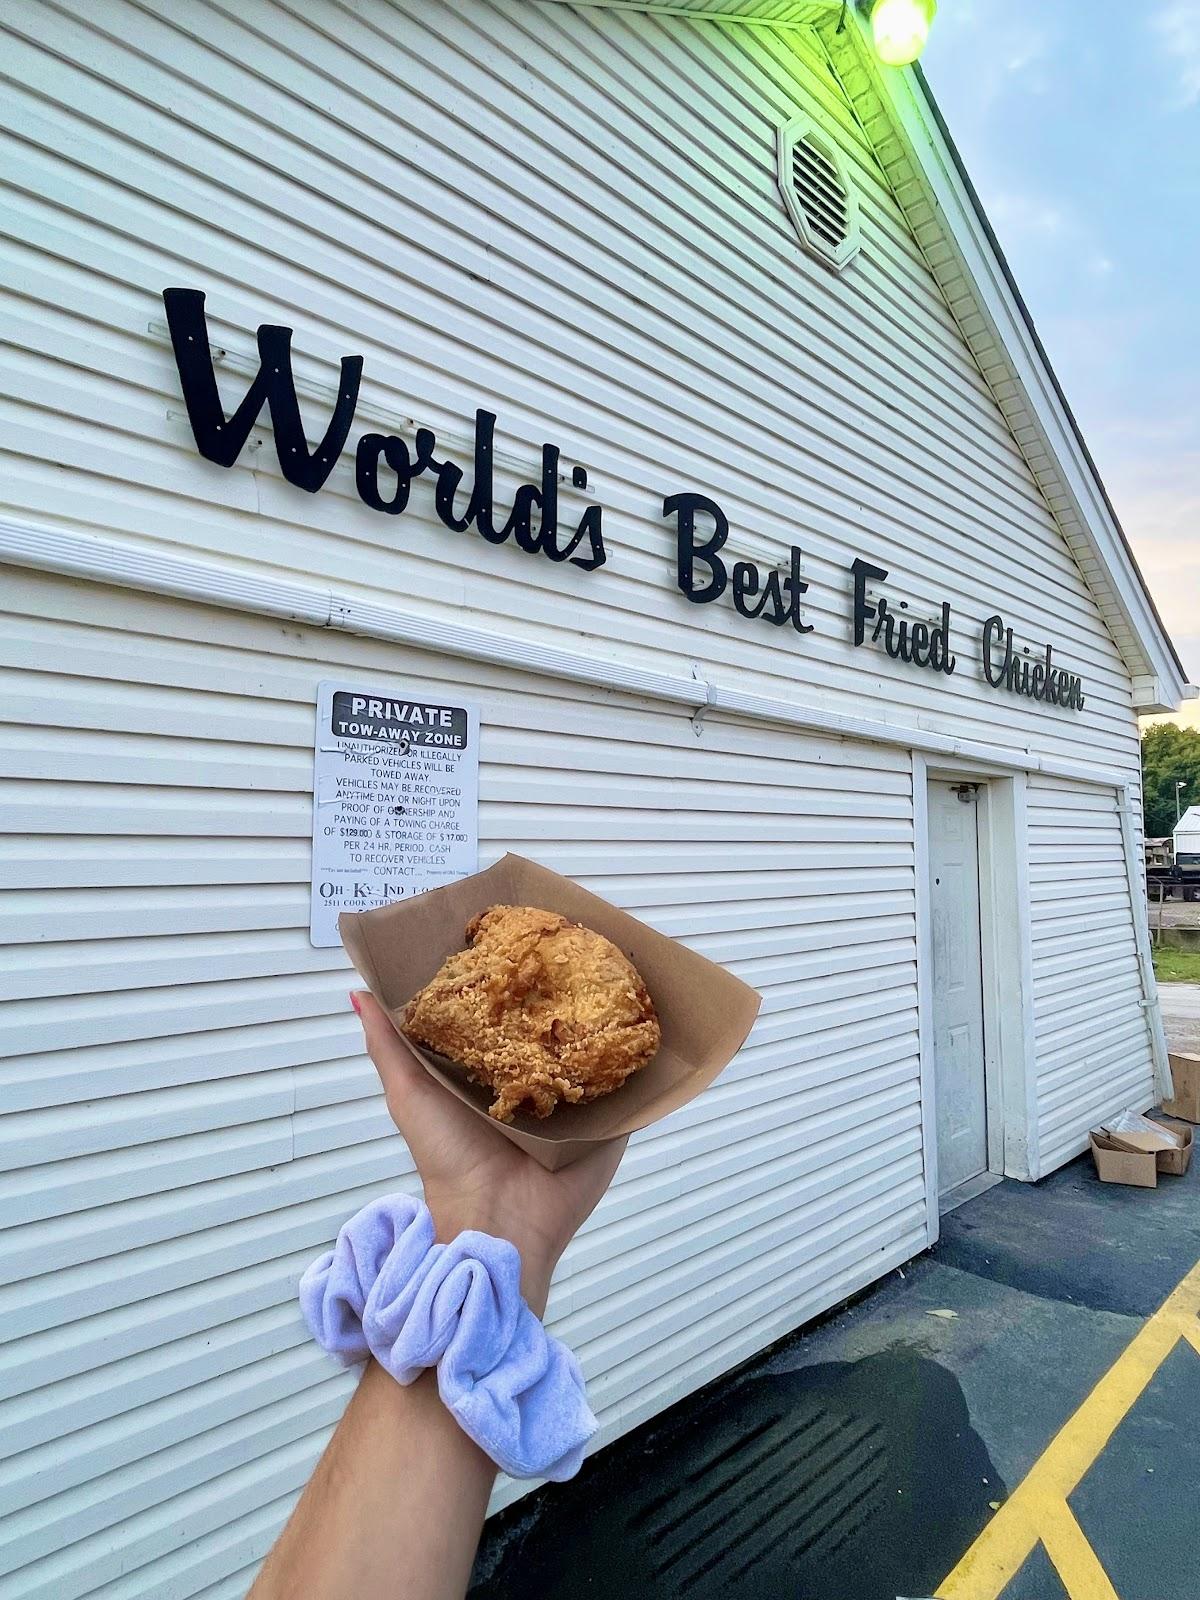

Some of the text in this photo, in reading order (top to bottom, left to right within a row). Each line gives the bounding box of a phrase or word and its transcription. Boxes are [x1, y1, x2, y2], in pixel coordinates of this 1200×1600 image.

[663, 493, 814, 634] Best
[850, 558, 955, 675] Fried
[982, 615, 1085, 711] Chicken
[351, 697, 453, 728] PRIVATE
[338, 721, 462, 747] TOW-AWAY ZONE
[344, 753, 455, 773] PARKED VEHICLES WILL BE
[406, 749, 418, 759] OR
[420, 751, 462, 762] ILLEGALLY
[371, 768, 402, 780] TOWED
[335, 777, 462, 796] VEHICLES MAY BE RECOVERED
[335, 790, 461, 808] ANYTIME DAY OR NIGHT UPON
[341, 803, 455, 819] PROOF OF ONERSHIP AND
[334, 814, 460, 831] PAYING OF A TOWING CHARGE
[323, 826, 336, 836] OF
[375, 829, 381, 839] &
[385, 830, 424, 841] STORAGE
[426, 832, 437, 841] OF
[343, 840, 360, 850] PER
[363, 841, 375, 851] 24
[429, 844, 451, 854] CASH
[350, 853, 446, 865] TO RECOVER VEHICLES
[343, 899, 367, 907] COOK
